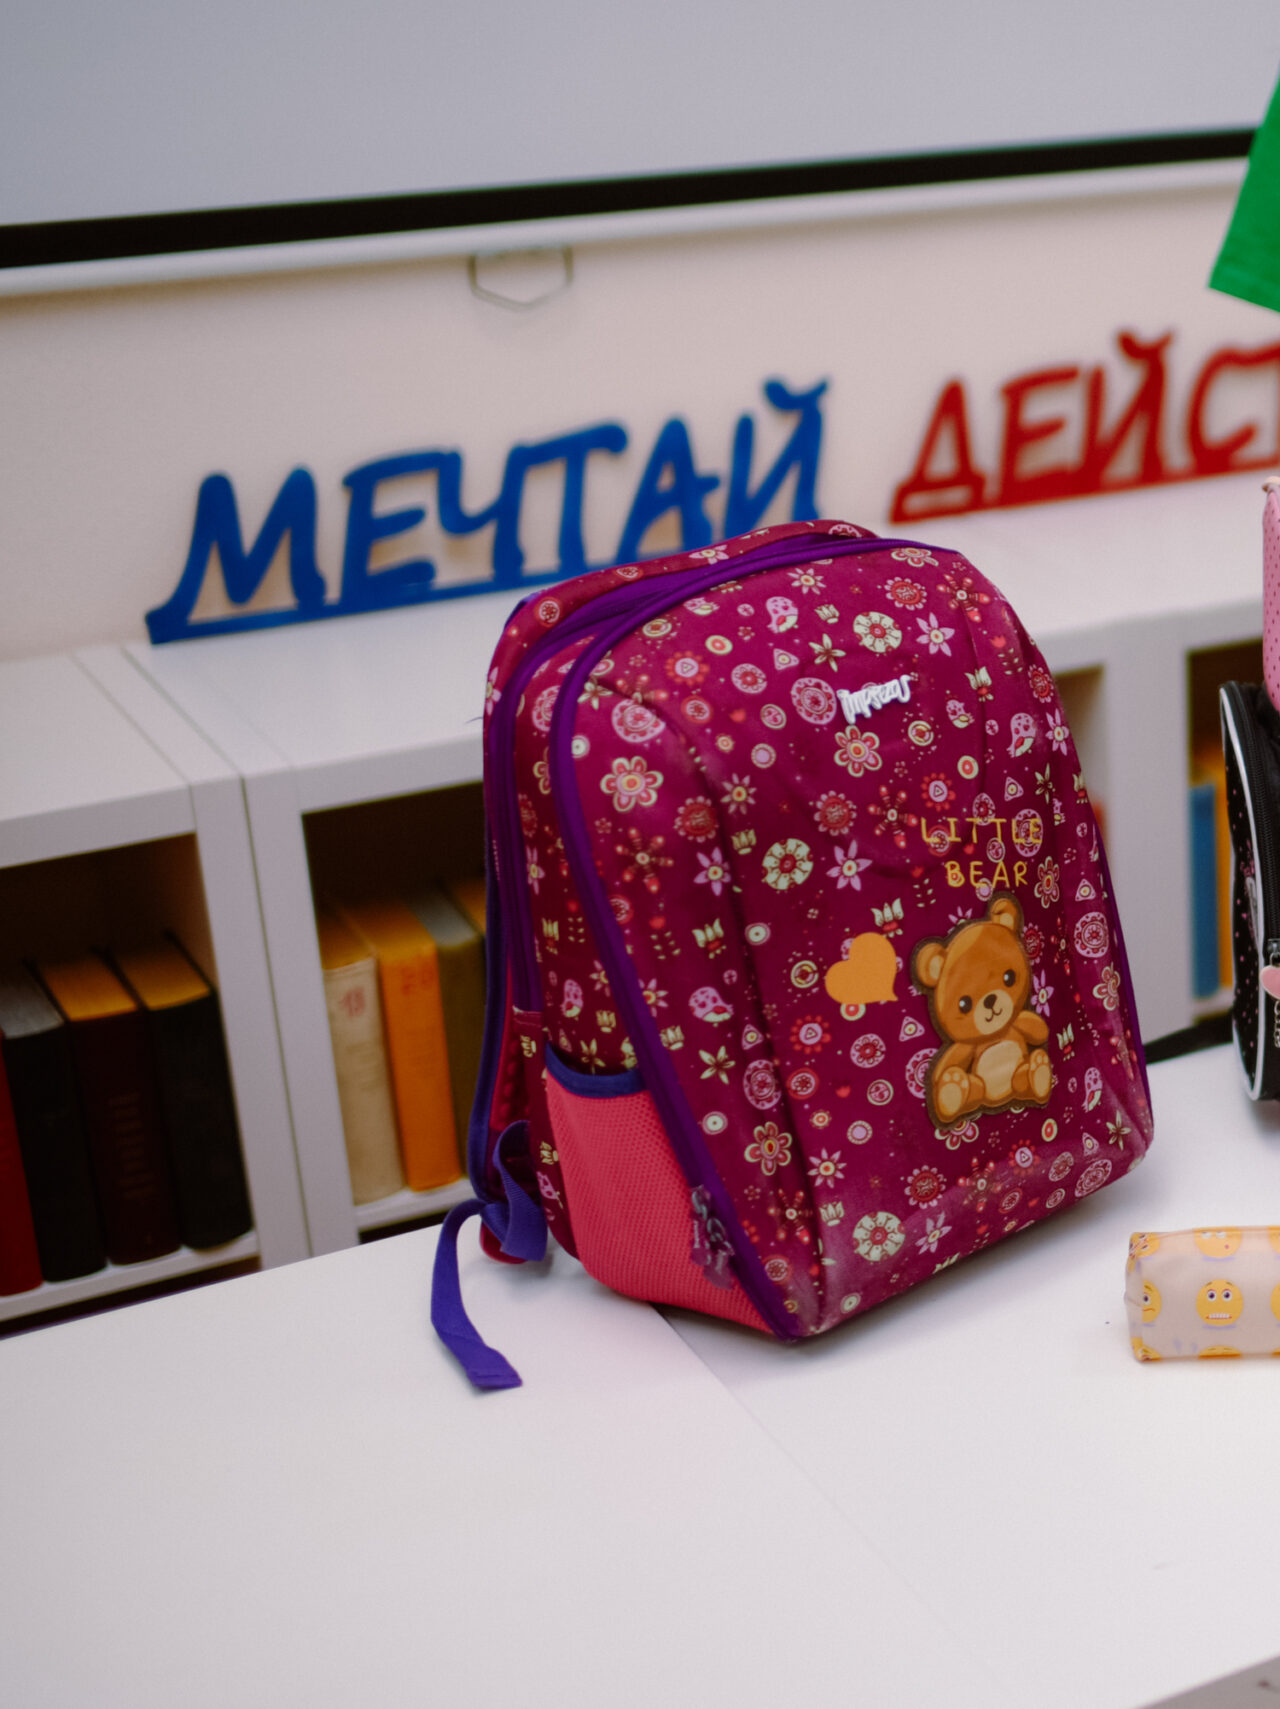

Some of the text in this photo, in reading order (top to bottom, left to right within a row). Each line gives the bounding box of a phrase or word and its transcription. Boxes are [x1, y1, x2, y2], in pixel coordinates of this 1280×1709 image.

[145, 376, 830, 645] МЕЧТАЙ
[920, 816, 1043, 844] LITTLE
[945, 860, 1028, 888] BEAR
